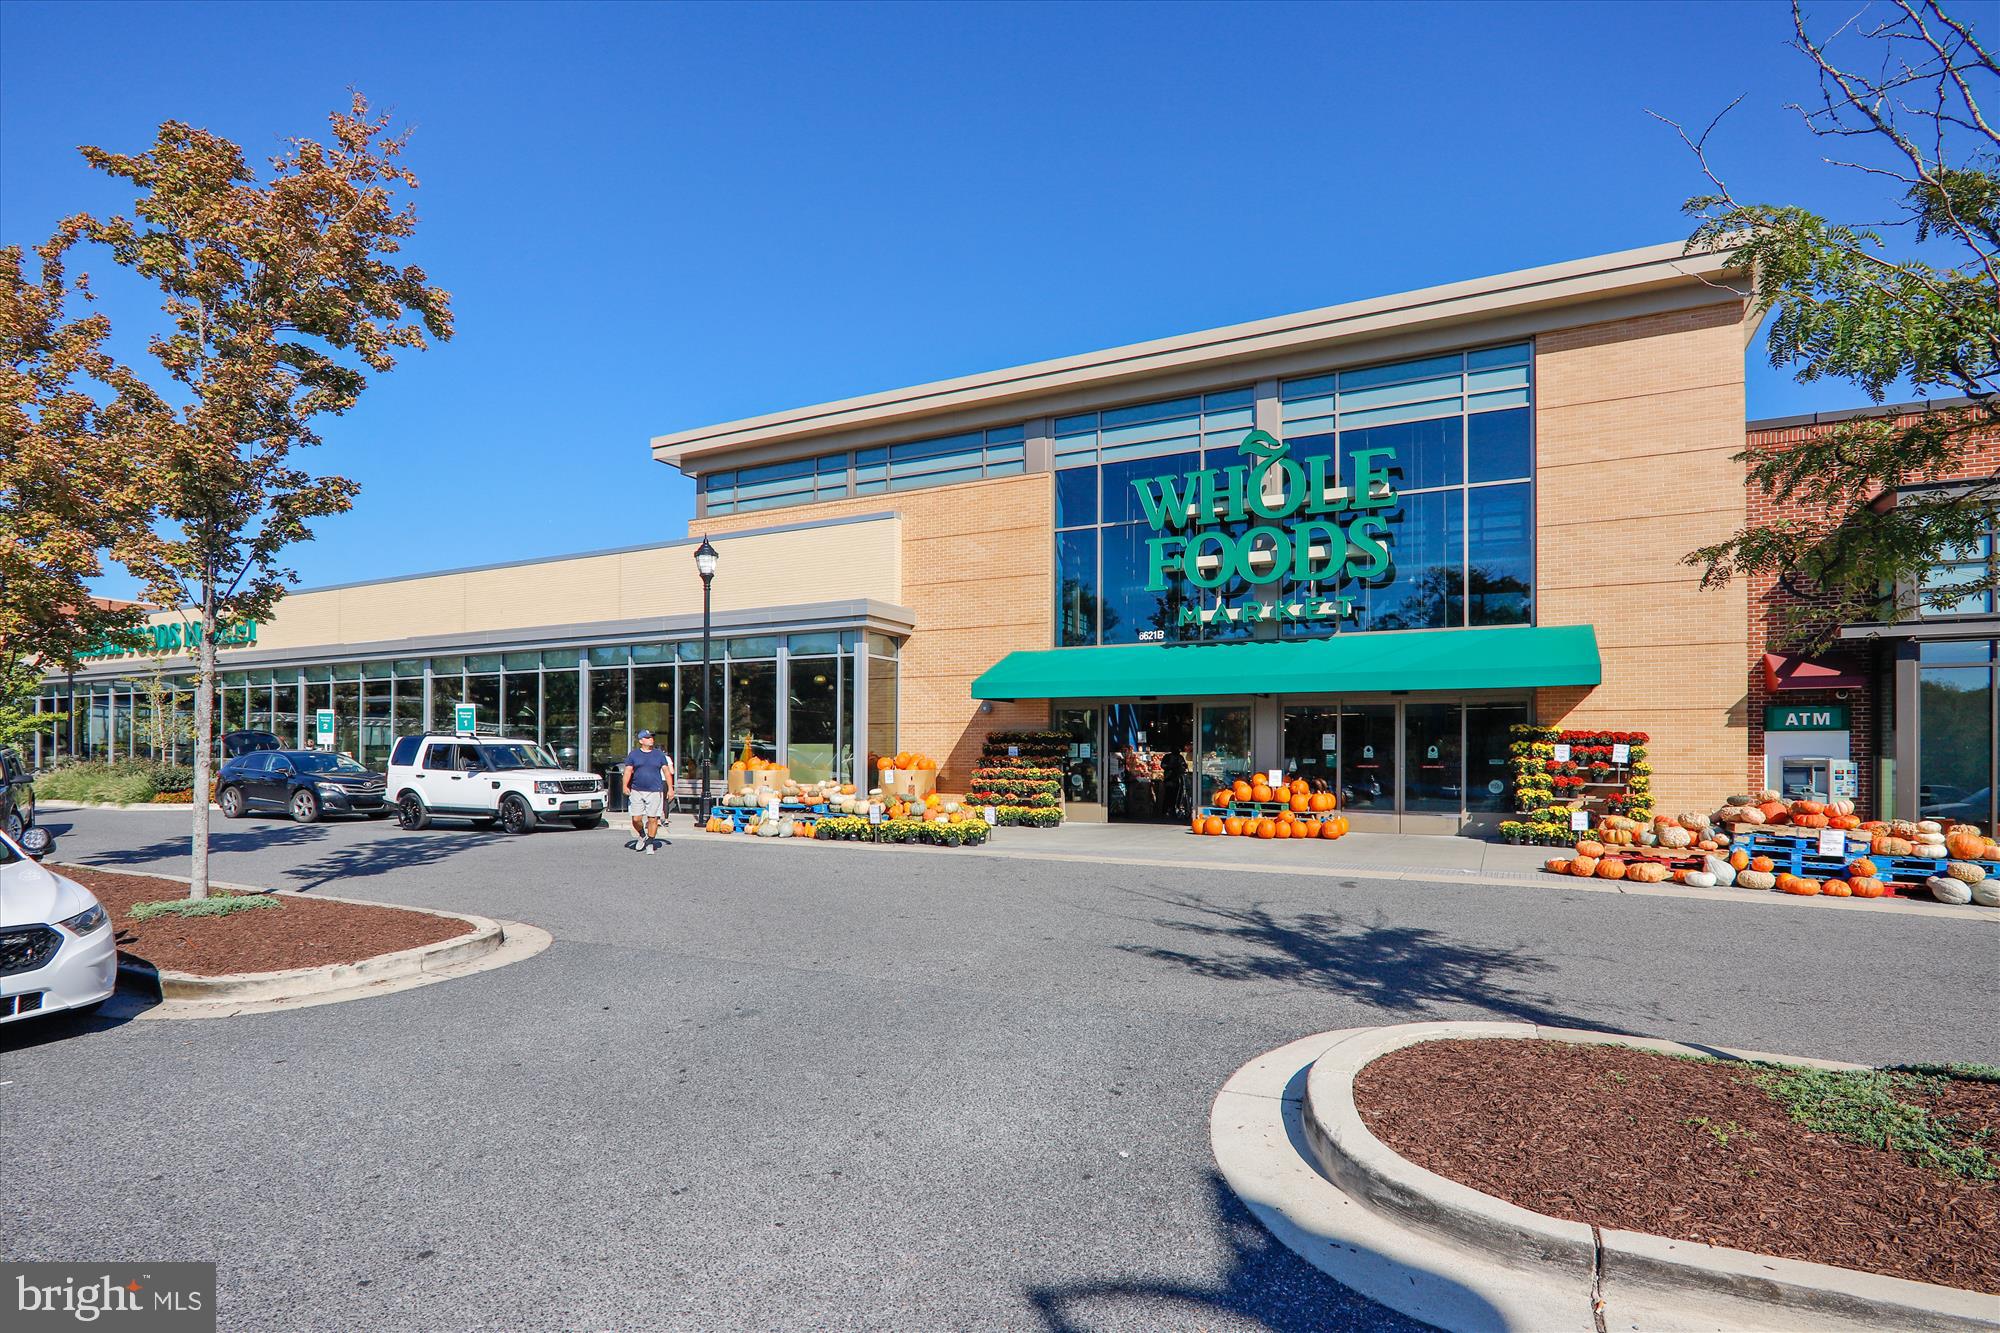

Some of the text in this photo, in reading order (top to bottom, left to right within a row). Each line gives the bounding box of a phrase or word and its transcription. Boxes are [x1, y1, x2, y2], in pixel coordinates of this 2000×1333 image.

[1130, 446, 1398, 531] WHOLE
[1144, 516, 1391, 592] FOODS
[1177, 595, 1357, 627] MARKET
[1785, 712, 1830, 726] ATM
